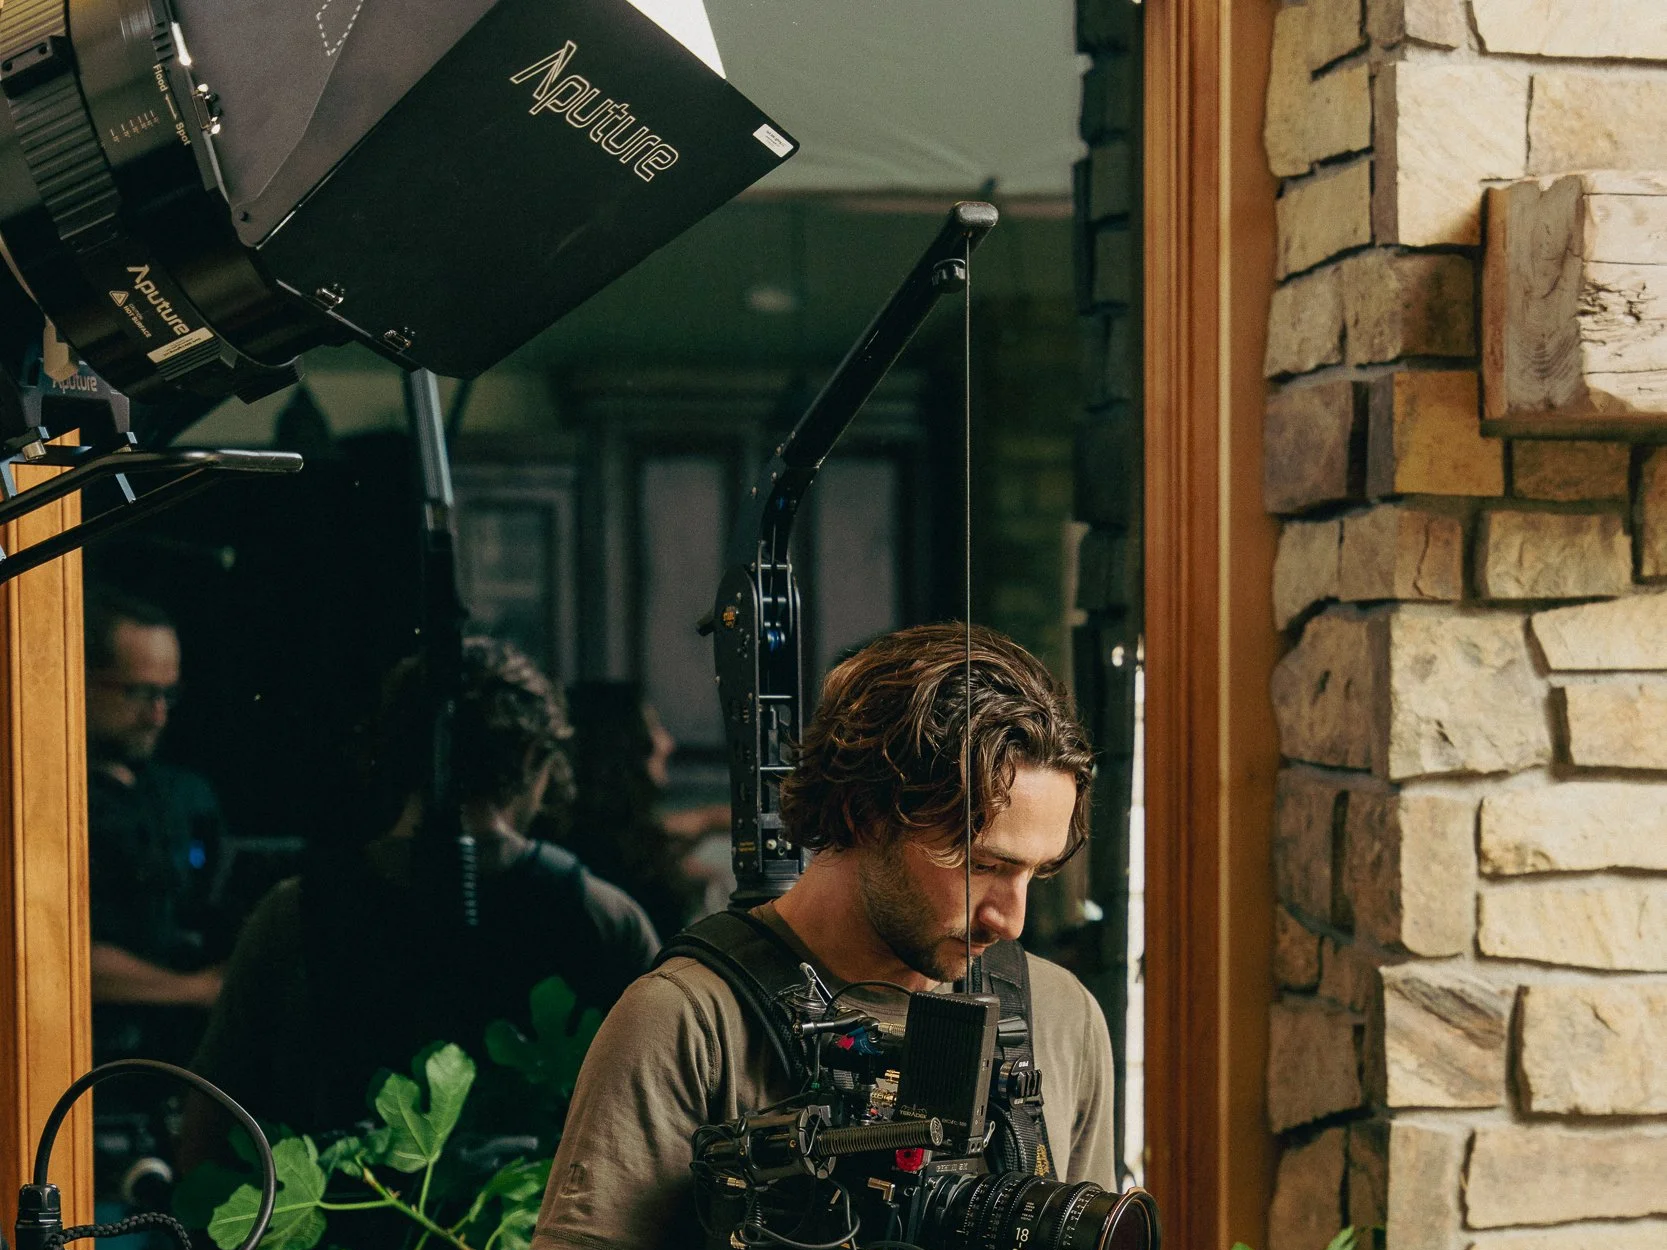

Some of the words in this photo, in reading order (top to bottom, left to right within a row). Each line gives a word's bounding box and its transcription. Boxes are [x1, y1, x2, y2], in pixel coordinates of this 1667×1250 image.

[153, 63, 168, 92] Flood
[175, 122, 191, 146] Spot
[509, 40, 679, 182] Aputure
[126, 264, 190, 336] Aputure
[52, 373, 98, 394] puture
[1016, 1227, 1030, 1242] 18
